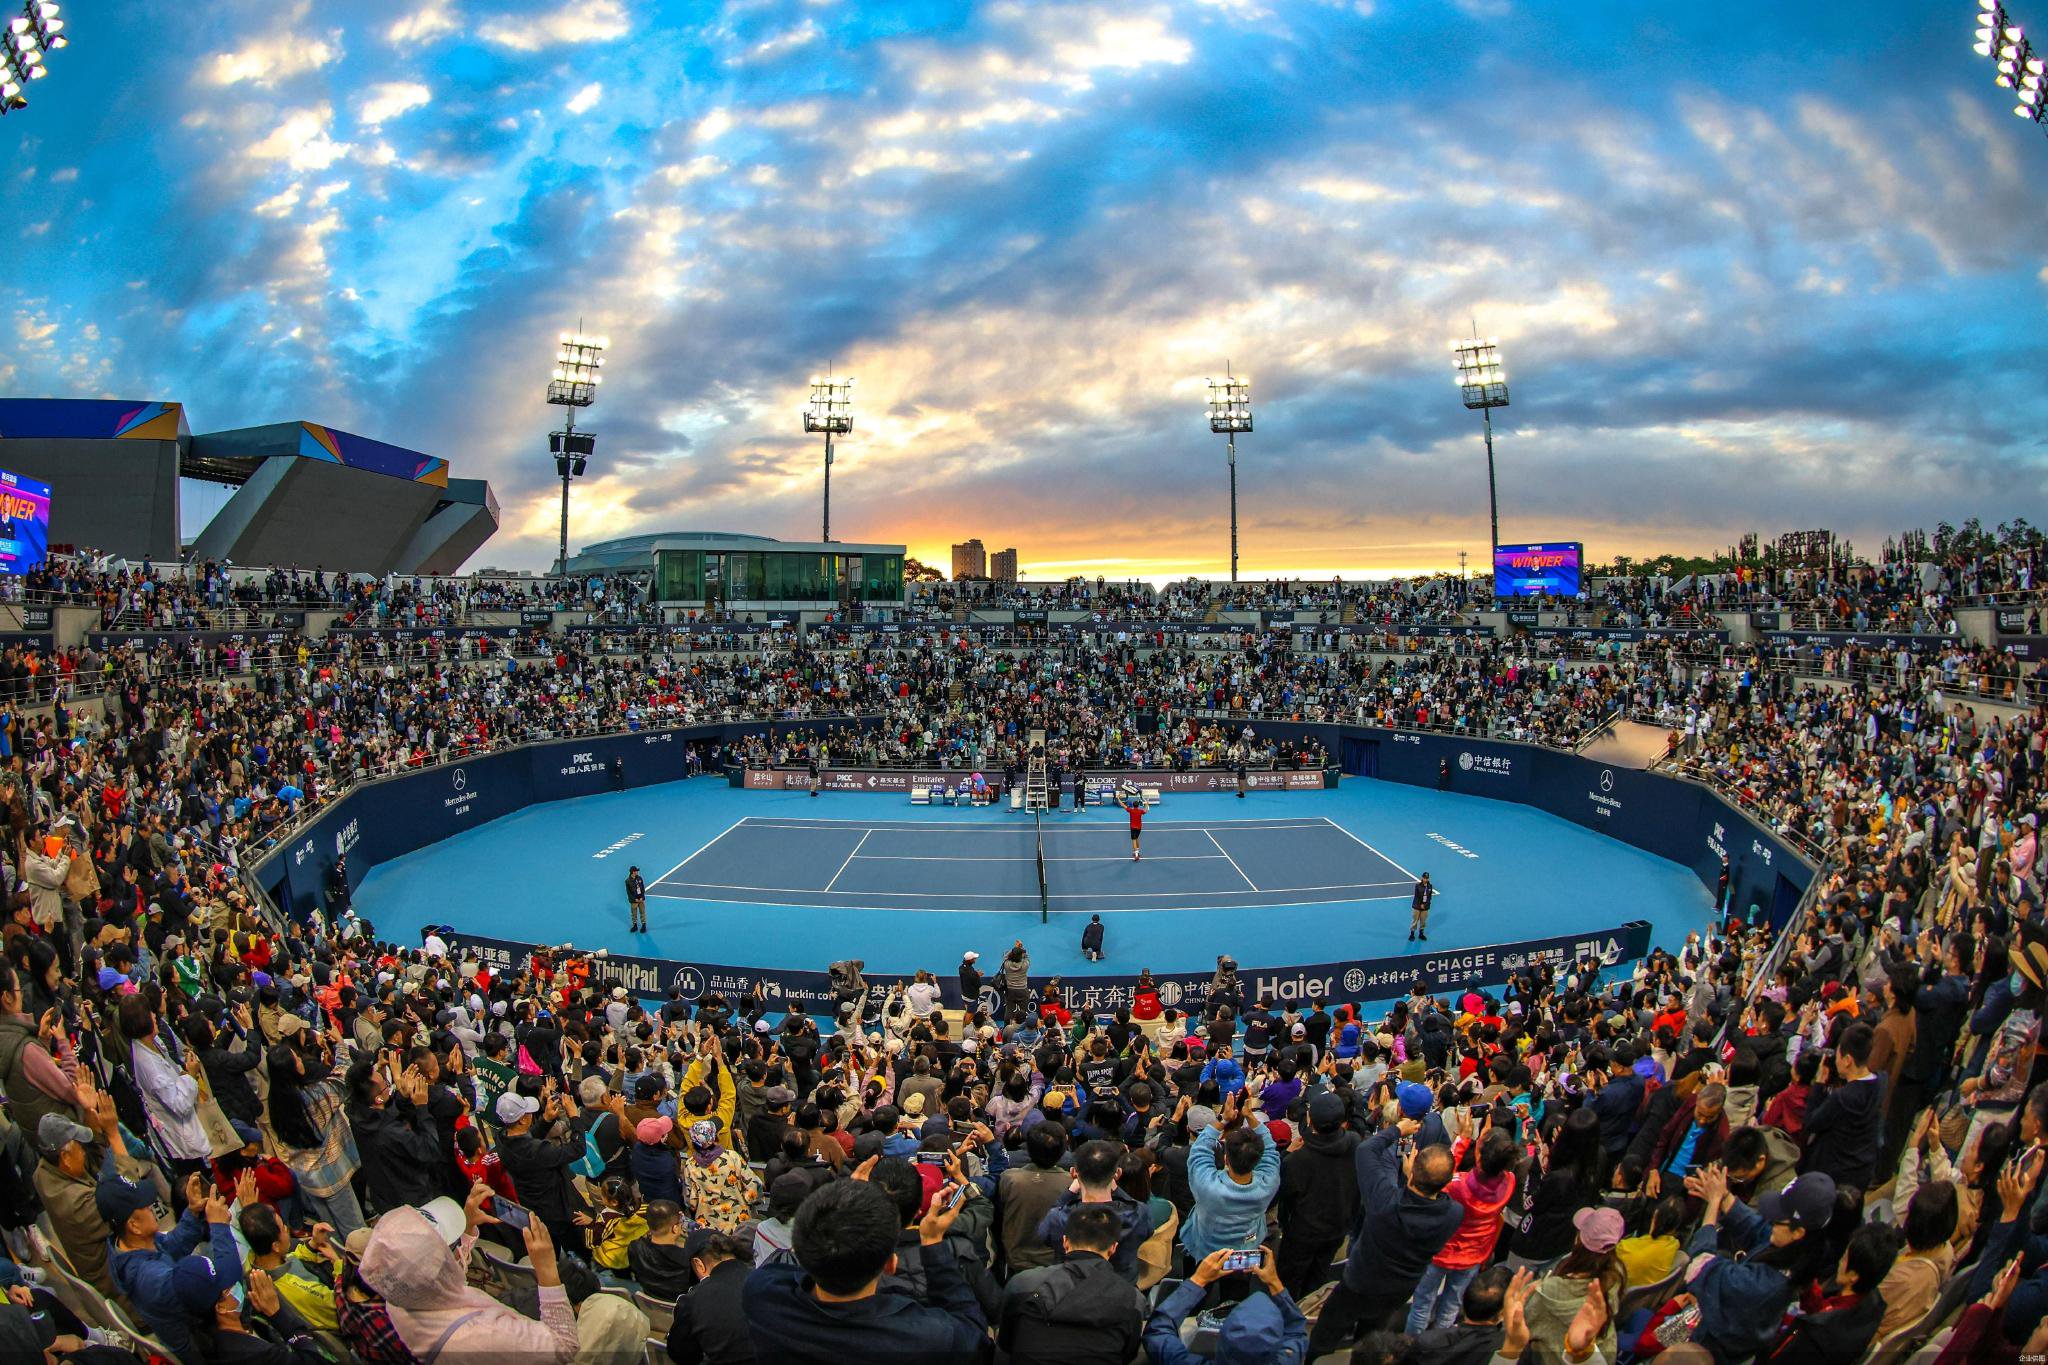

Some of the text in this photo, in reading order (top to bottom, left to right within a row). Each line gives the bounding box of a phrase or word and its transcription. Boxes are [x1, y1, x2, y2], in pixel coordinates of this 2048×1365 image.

[573, 753, 593, 764] PICC
[1474, 755, 1511, 769] 中信银行
[561, 763, 606, 776] 中国人民保险
[471, 945, 511, 963] 利亚德
[1528, 948, 1564, 961] 燕啤酒
[1575, 938, 1620, 966] FILA
[1425, 953, 1496, 973] CHAGEE
[710, 975, 749, 990] 品品香
[1367, 968, 1420, 987] 北京同仁堂
[786, 988, 815, 1000] luckin
[1183, 981, 1245, 997] 中信行
[1256, 973, 1334, 1001] Haier
[1251, 1019, 1268, 1030] FILA
[476, 1067, 506, 1089] EKING
